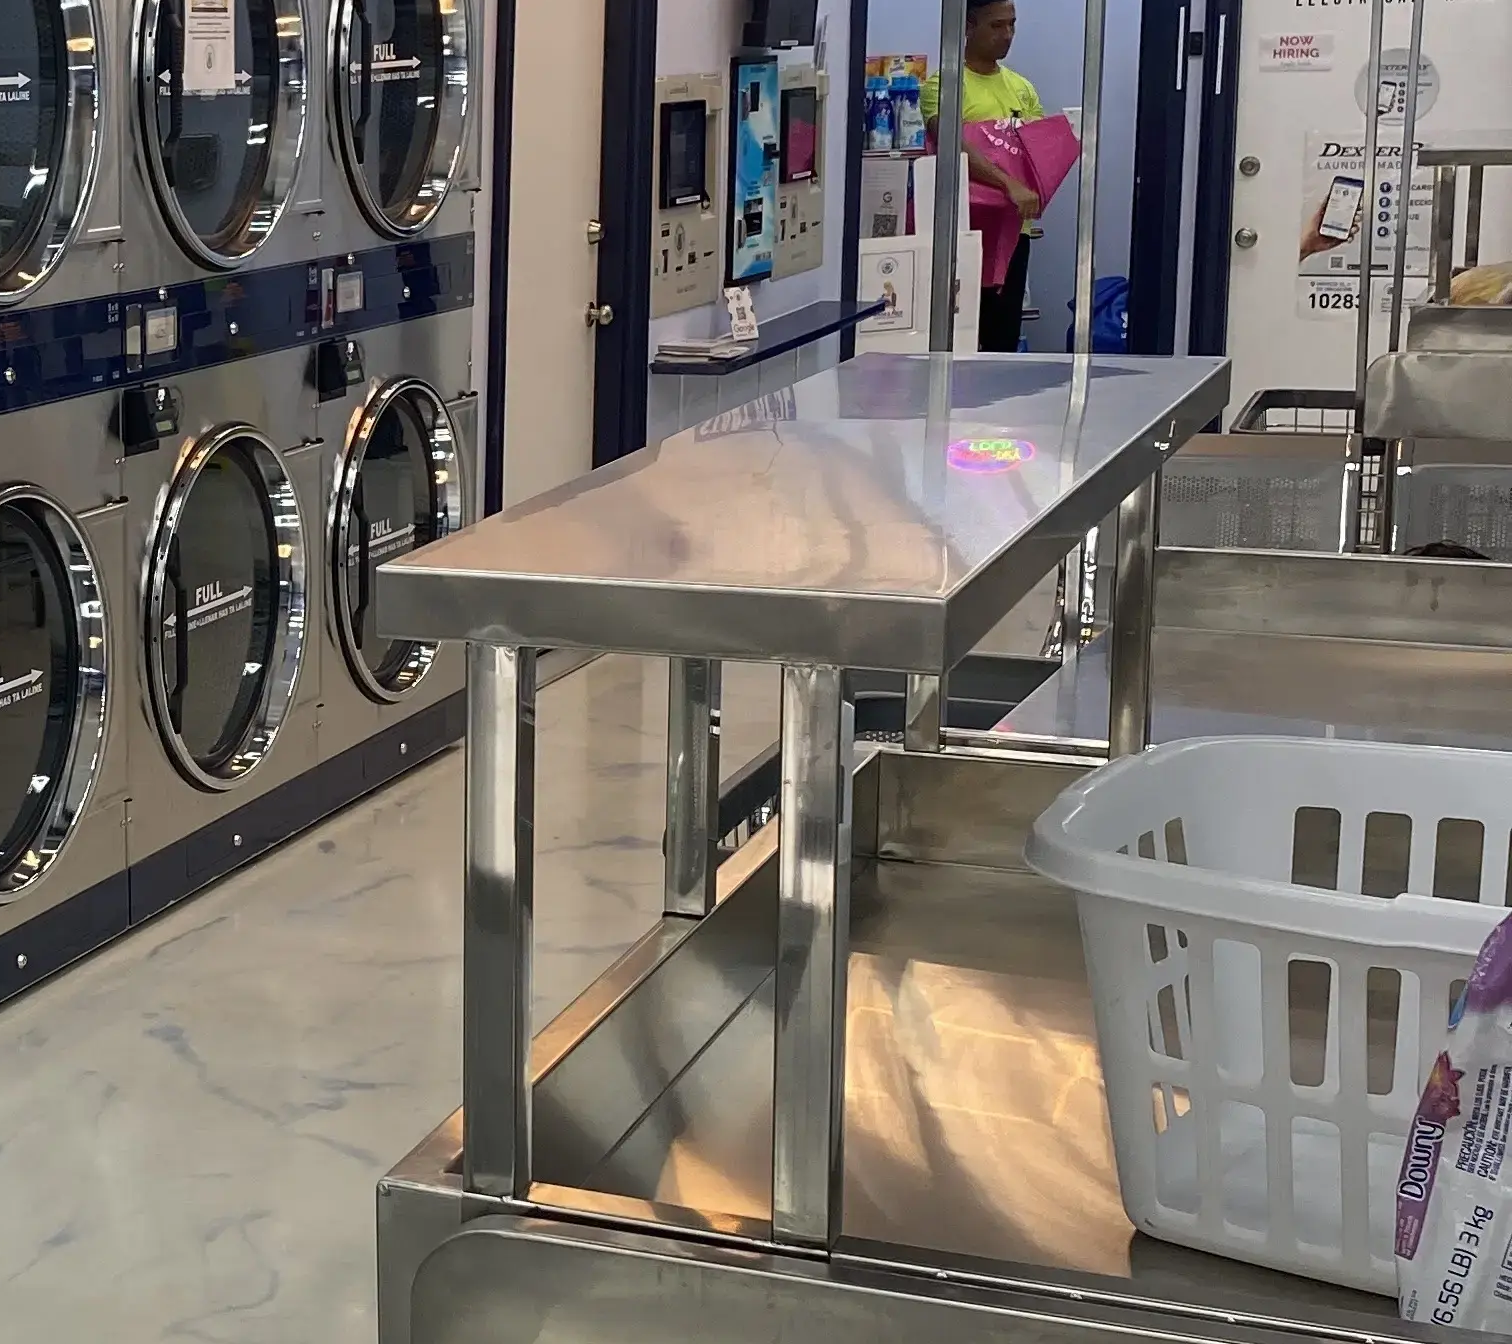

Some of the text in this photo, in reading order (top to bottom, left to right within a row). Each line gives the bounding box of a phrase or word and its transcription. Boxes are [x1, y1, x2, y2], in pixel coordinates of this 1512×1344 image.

[1279, 36, 1314, 47] NOW
[373, 43, 396, 60] FULL
[1273, 48, 1320, 59] HIRING
[1317, 161, 1402, 170] LAUNDR MAD
[371, 518, 392, 540] FULL
[195, 580, 223, 606] FULL
[1399, 1120, 1444, 1199] Downy
[1431, 1205, 1493, 1325] (6.56 LB) 3 kg
